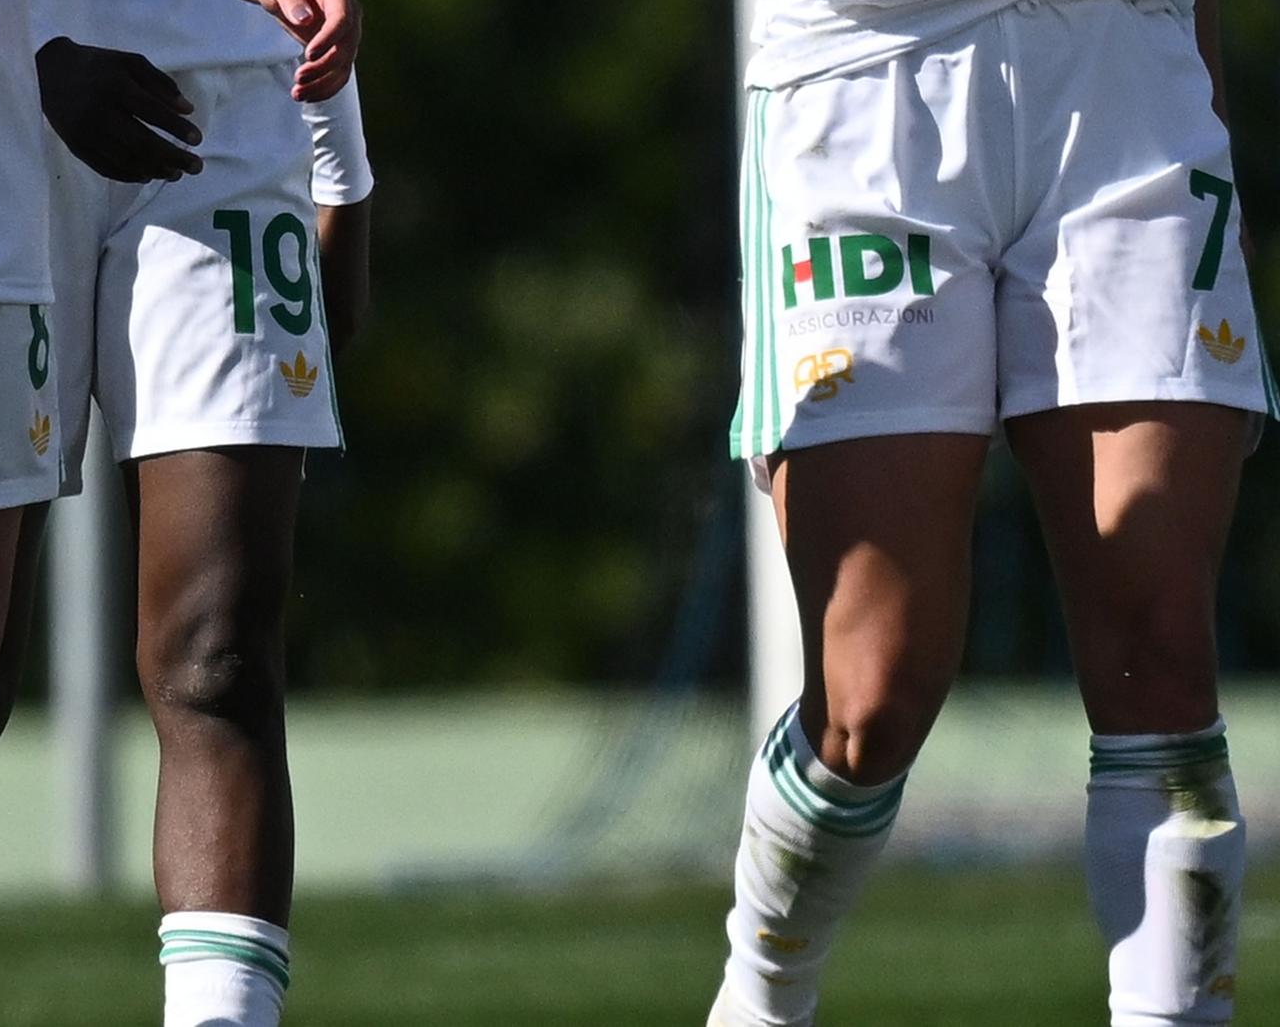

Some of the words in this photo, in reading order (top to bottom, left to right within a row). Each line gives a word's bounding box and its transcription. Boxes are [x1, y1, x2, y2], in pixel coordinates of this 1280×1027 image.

[213, 210, 312, 336] 19
[782, 234, 935, 309] HDI
[1190, 168, 1233, 291] 7
[788, 309, 934, 337] ASSICURAZIONI
